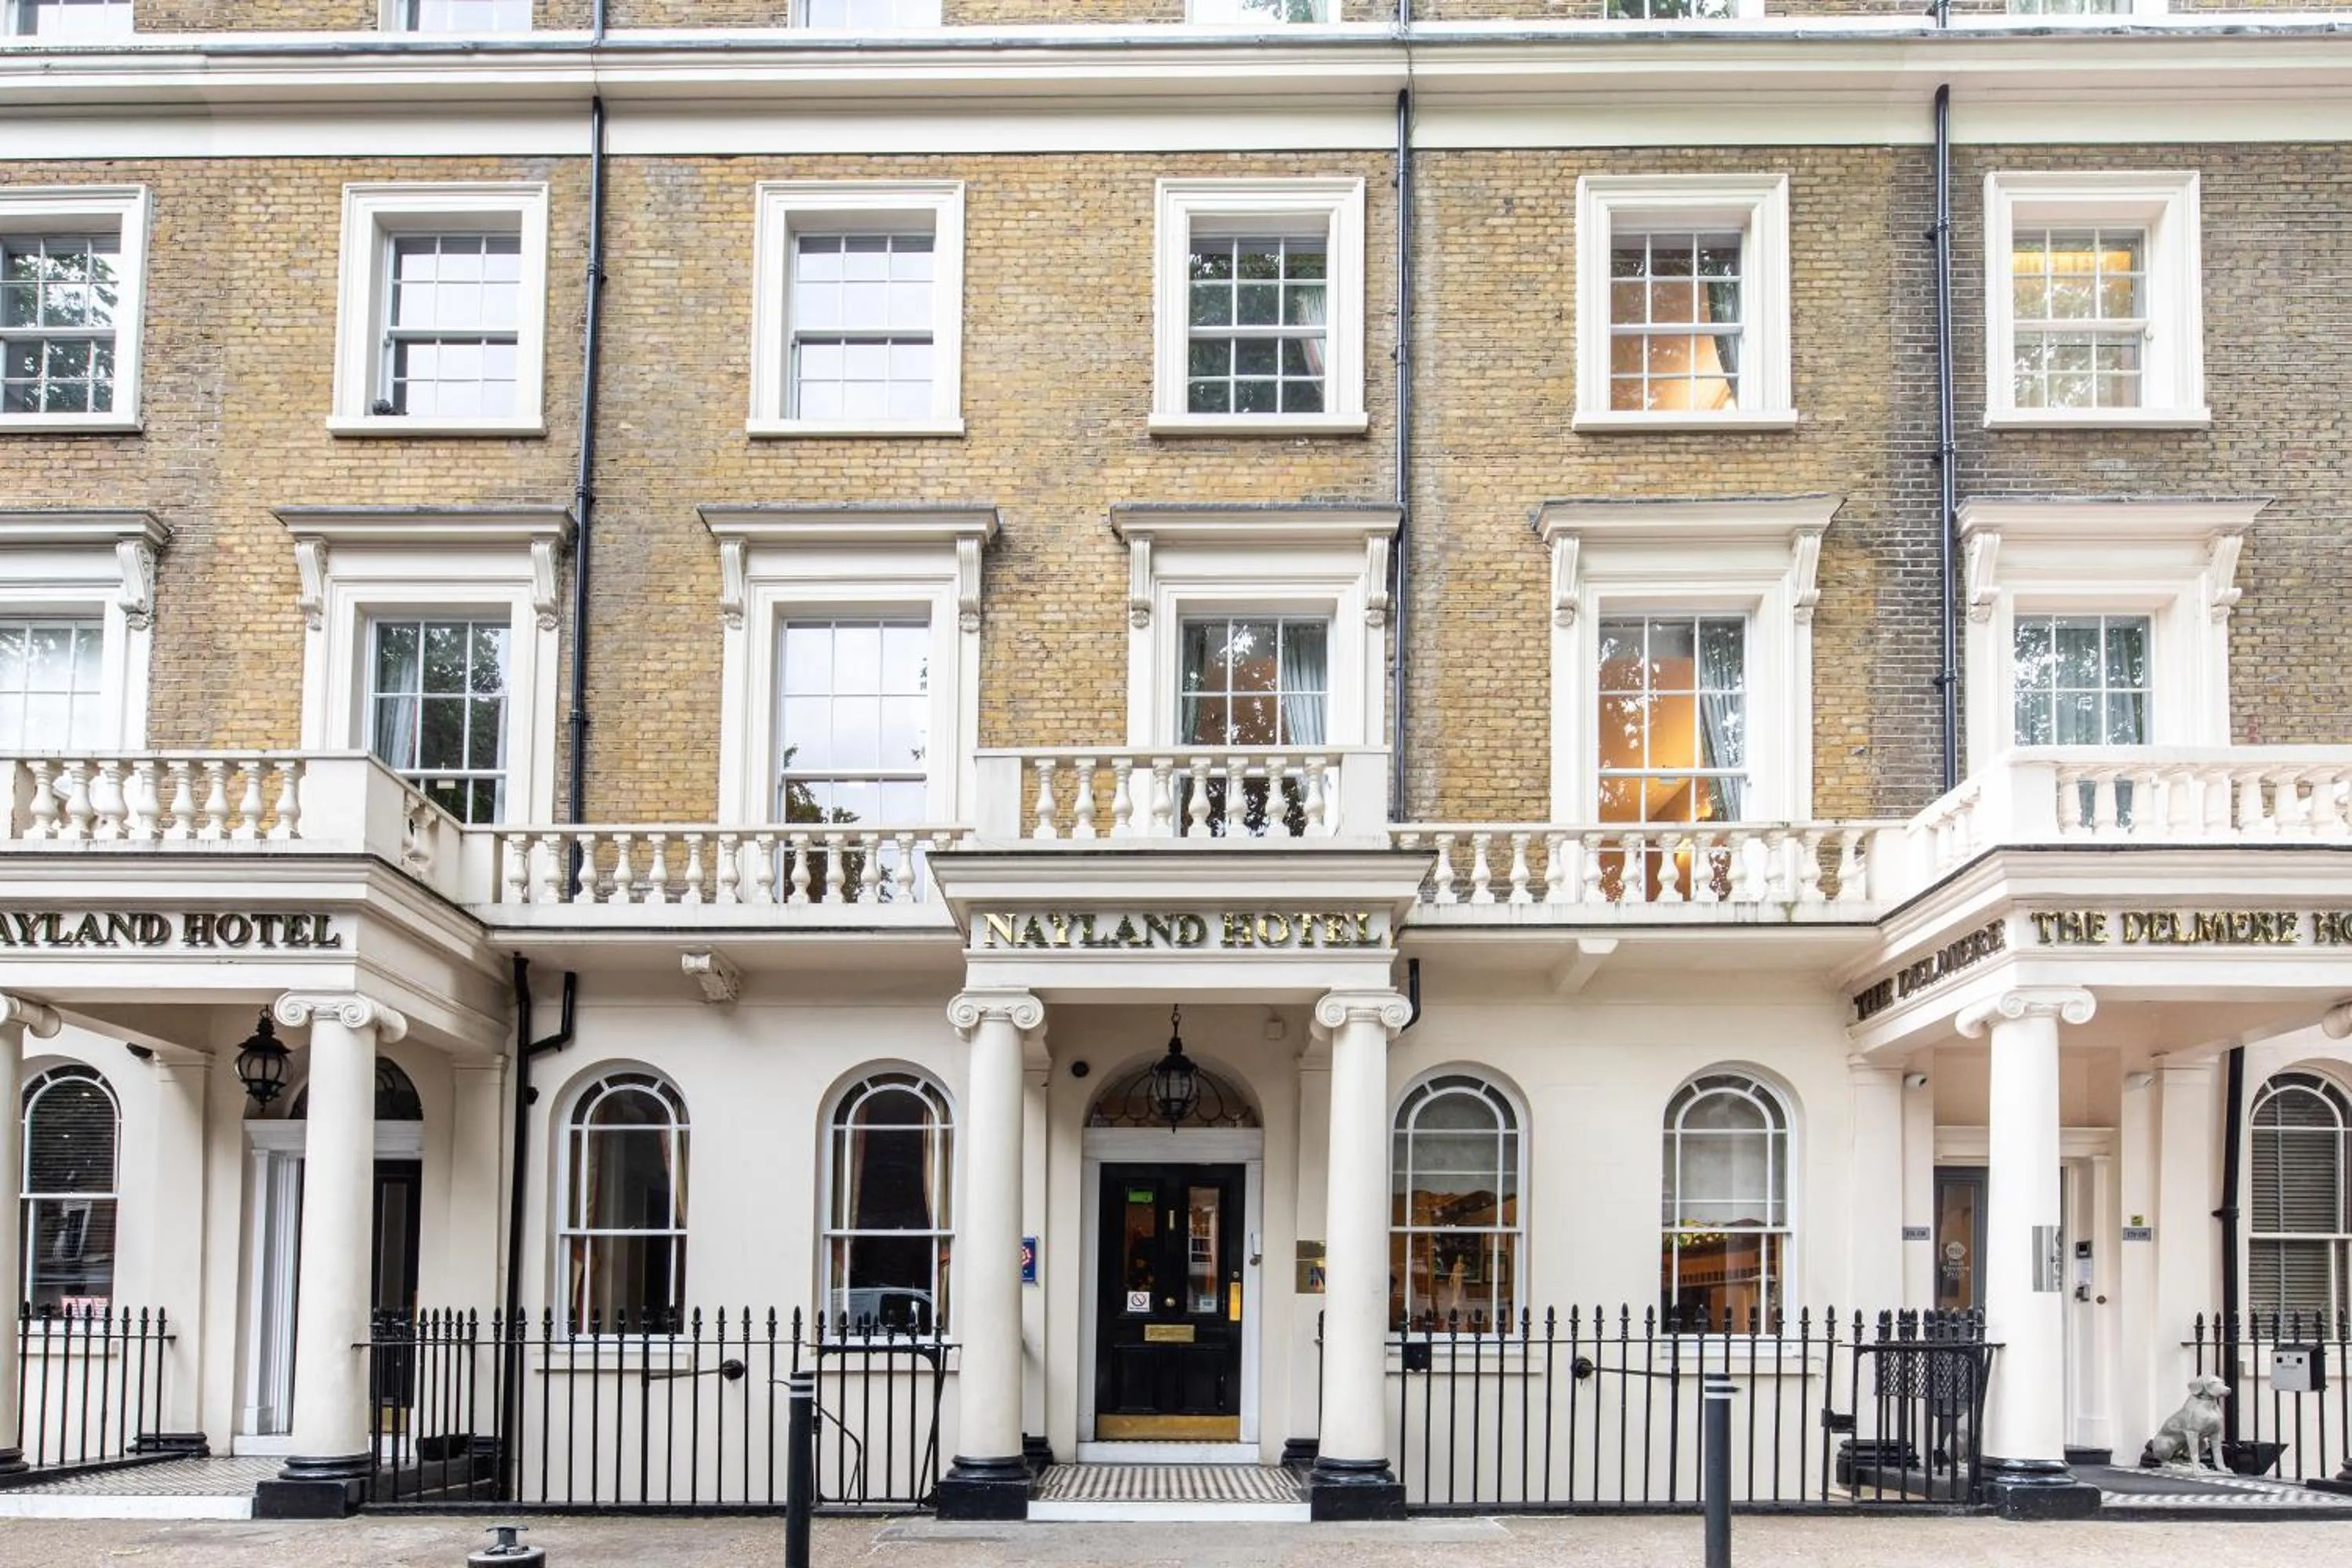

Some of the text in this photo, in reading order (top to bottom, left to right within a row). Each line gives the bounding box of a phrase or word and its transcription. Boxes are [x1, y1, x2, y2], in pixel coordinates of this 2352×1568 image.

[182, 913, 341, 948] HOTEL
[983, 912, 1383, 949] NAYLAND HOTEL
[2030, 911, 2110, 944] THE
[2120, 911, 2302, 946] DELMERE
